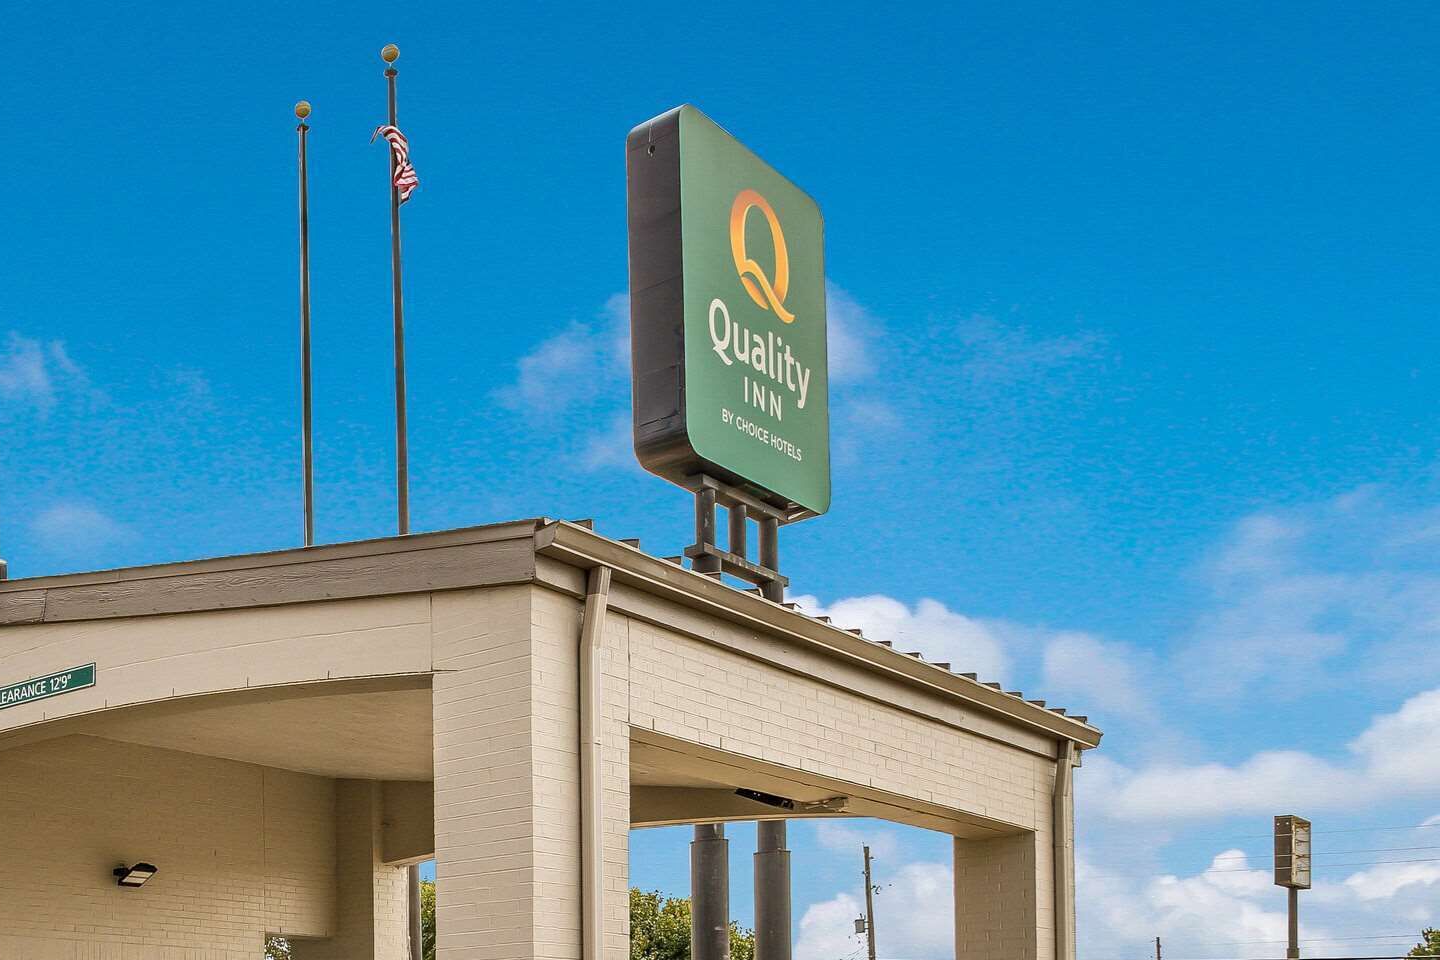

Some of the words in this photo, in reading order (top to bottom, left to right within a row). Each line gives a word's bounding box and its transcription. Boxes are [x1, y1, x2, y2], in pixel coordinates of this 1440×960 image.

[709, 298, 810, 409] Quality
[744, 376, 782, 421] INN
[722, 408, 734, 425] BY
[736, 416, 769, 444] CHOICE
[770, 433, 802, 461] HOTELS
